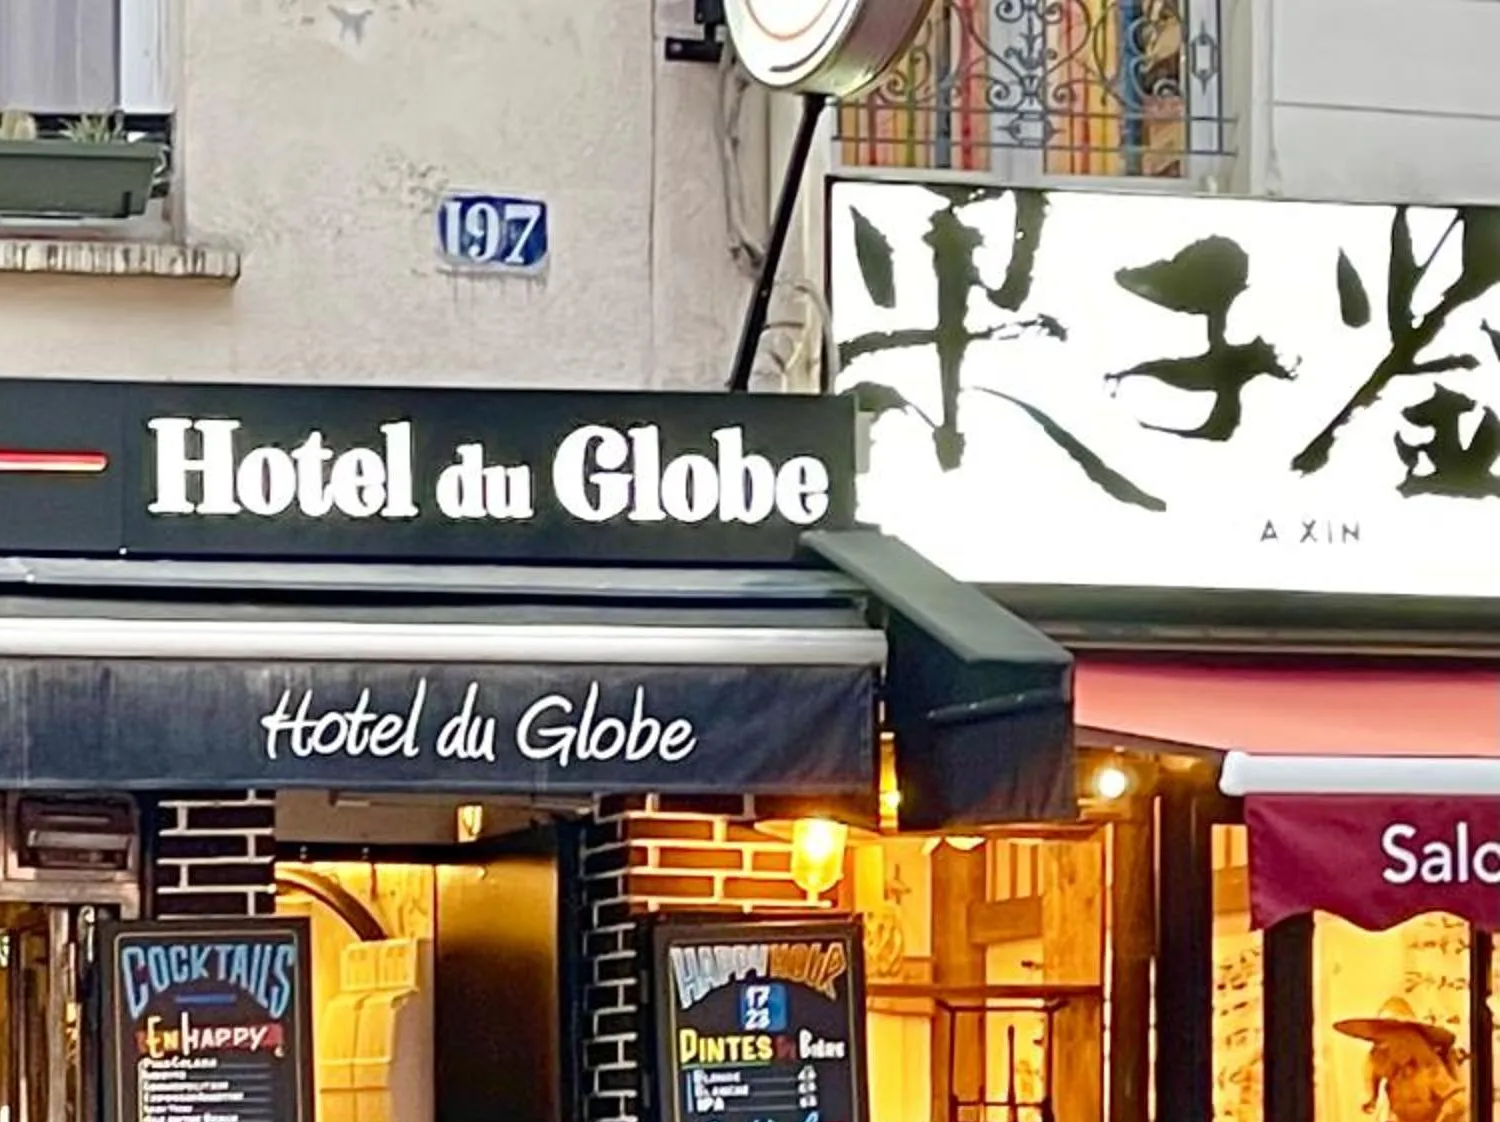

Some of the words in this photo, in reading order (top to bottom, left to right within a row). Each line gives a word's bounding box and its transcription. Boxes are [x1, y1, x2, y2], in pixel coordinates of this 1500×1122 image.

[444, 200, 542, 264] 197
[147, 417, 420, 519] Hotel
[435, 444, 534, 521] du
[552, 423, 831, 524] Globe
[260, 677, 429, 760] Hotel
[436, 681, 496, 761] du
[515, 680, 698, 768] Globe
[1380, 821, 1500, 884] Salo
[120, 943, 298, 1020] COCKTAILS
[180, 1010, 269, 1057] HAPPY
[679, 1028, 774, 1065] PINTES
